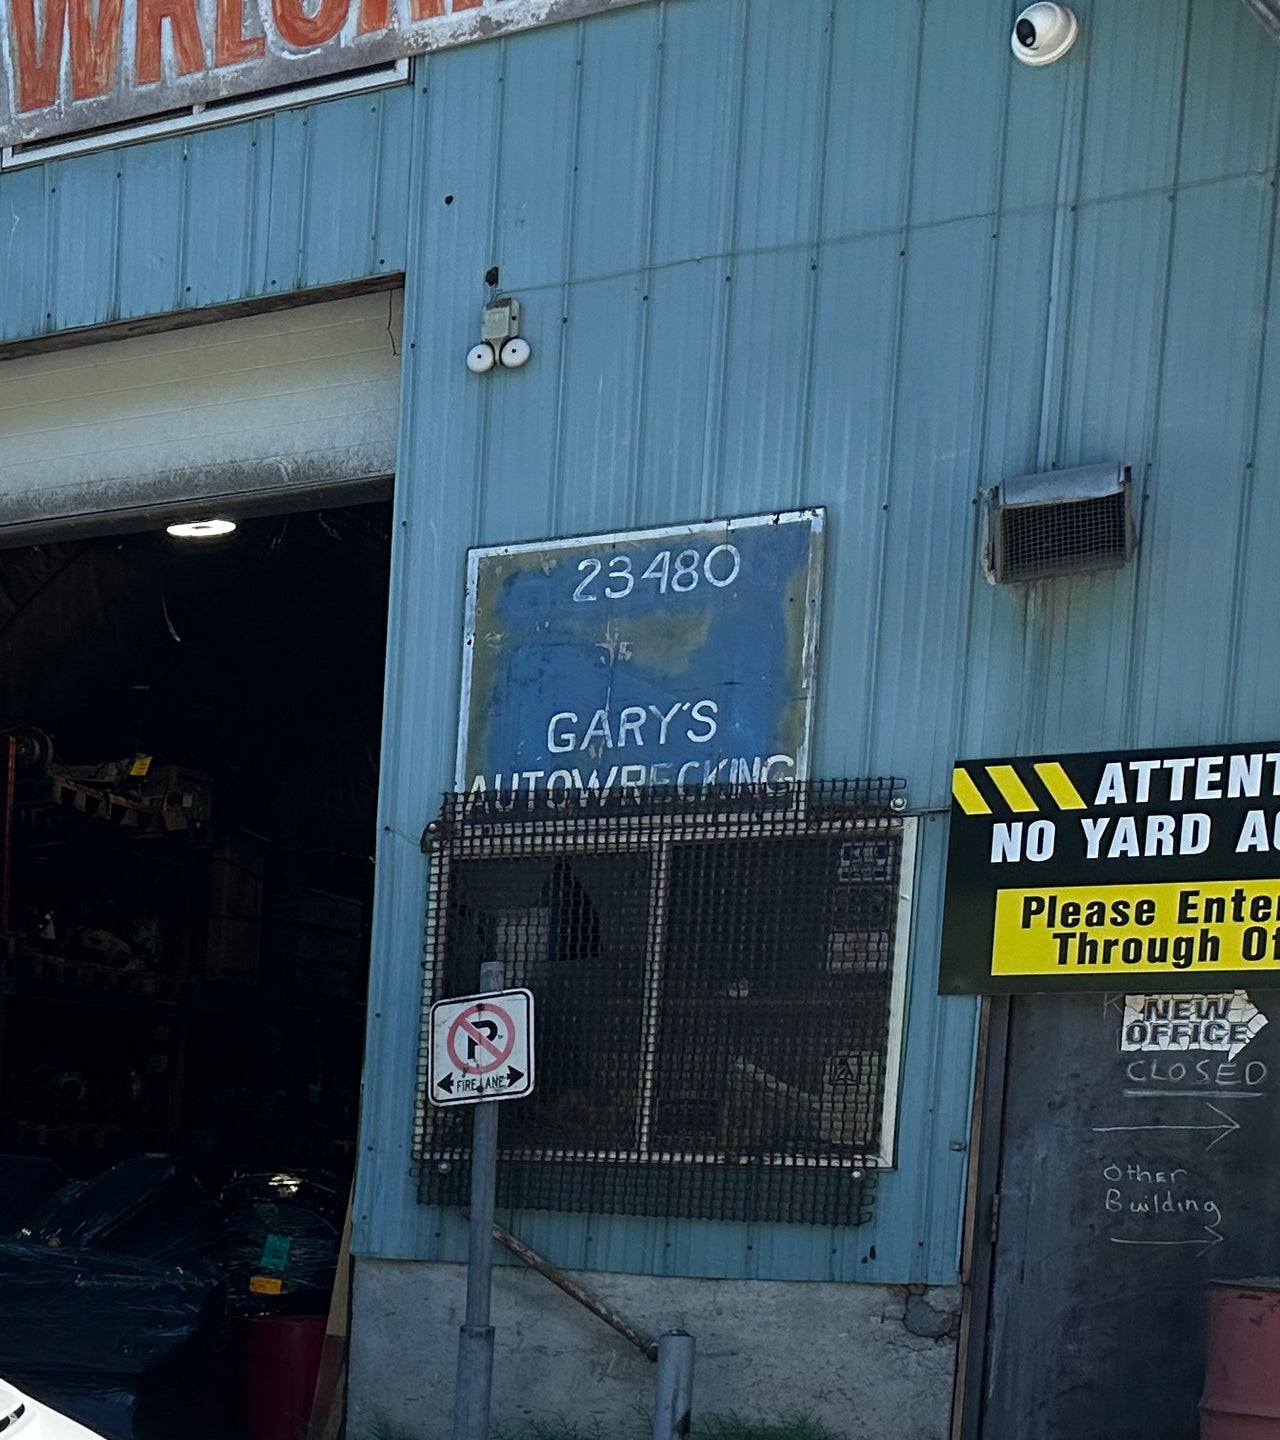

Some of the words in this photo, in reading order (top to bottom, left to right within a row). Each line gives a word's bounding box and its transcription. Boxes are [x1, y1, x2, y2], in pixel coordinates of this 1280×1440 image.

[572, 544, 741, 602] 23480
[547, 699, 719, 754] GARY'S
[990, 820, 1056, 863] NO
[1080, 813, 1212, 859] YARD
[1235, 810, 1280, 853] A
[1021, 894, 1156, 929] Please
[1178, 889, 1280, 924] Ente
[1052, 928, 1220, 969] Through
[1144, 999, 1233, 1021] NEW
[1125, 1022, 1249, 1045] OFFICE
[456, 1078, 477, 1092] FIRE
[1126, 1059, 1268, 1085] CLOSED
[1103, 1163, 1188, 1183] Other
[1105, 1188, 1222, 1227] Building
